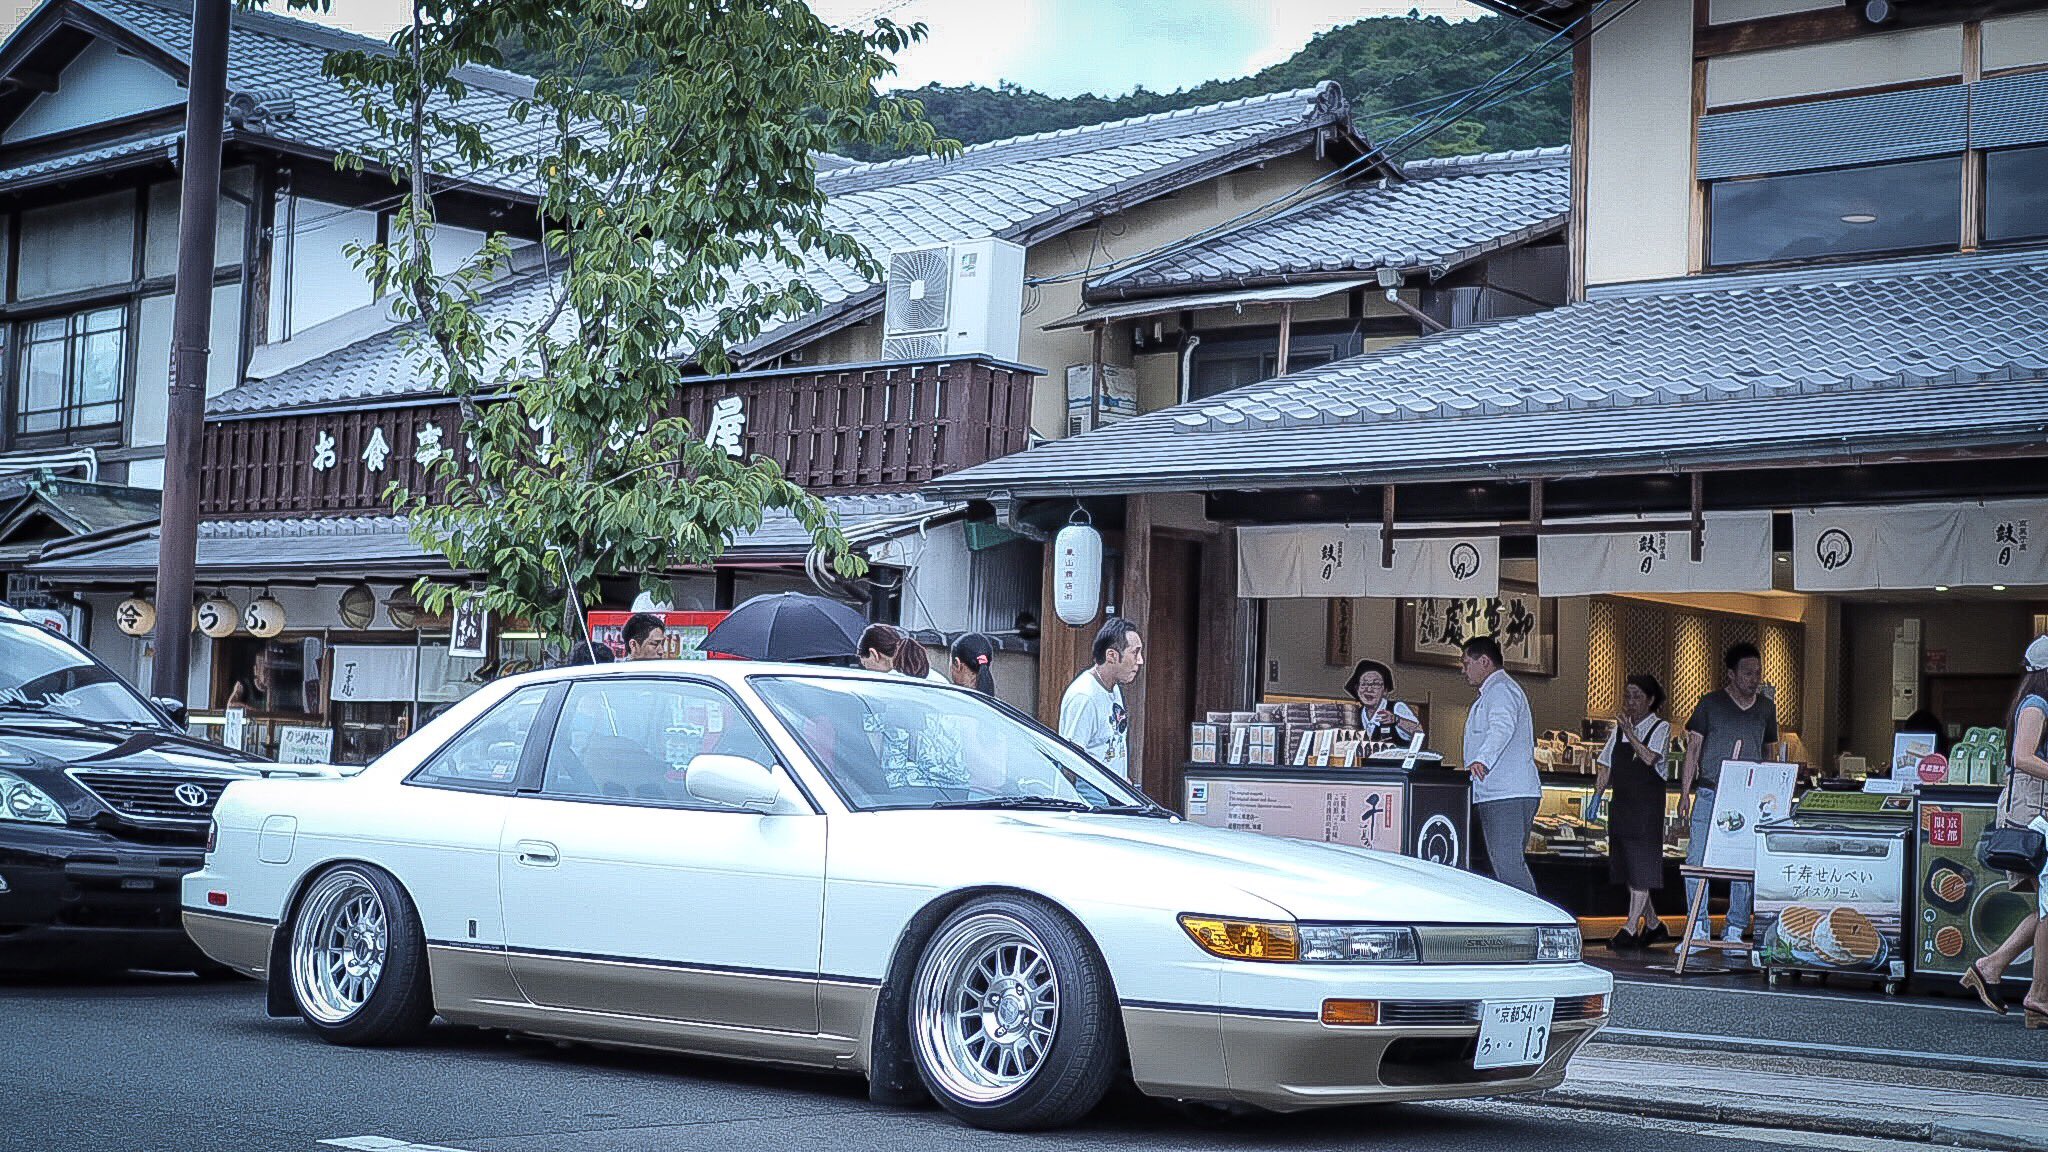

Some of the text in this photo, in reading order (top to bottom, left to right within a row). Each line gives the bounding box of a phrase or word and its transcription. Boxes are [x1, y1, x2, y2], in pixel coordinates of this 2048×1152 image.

[1782, 864, 1873, 884] 千寿せんべい
[1793, 885, 1859, 898] アイスクリーム
